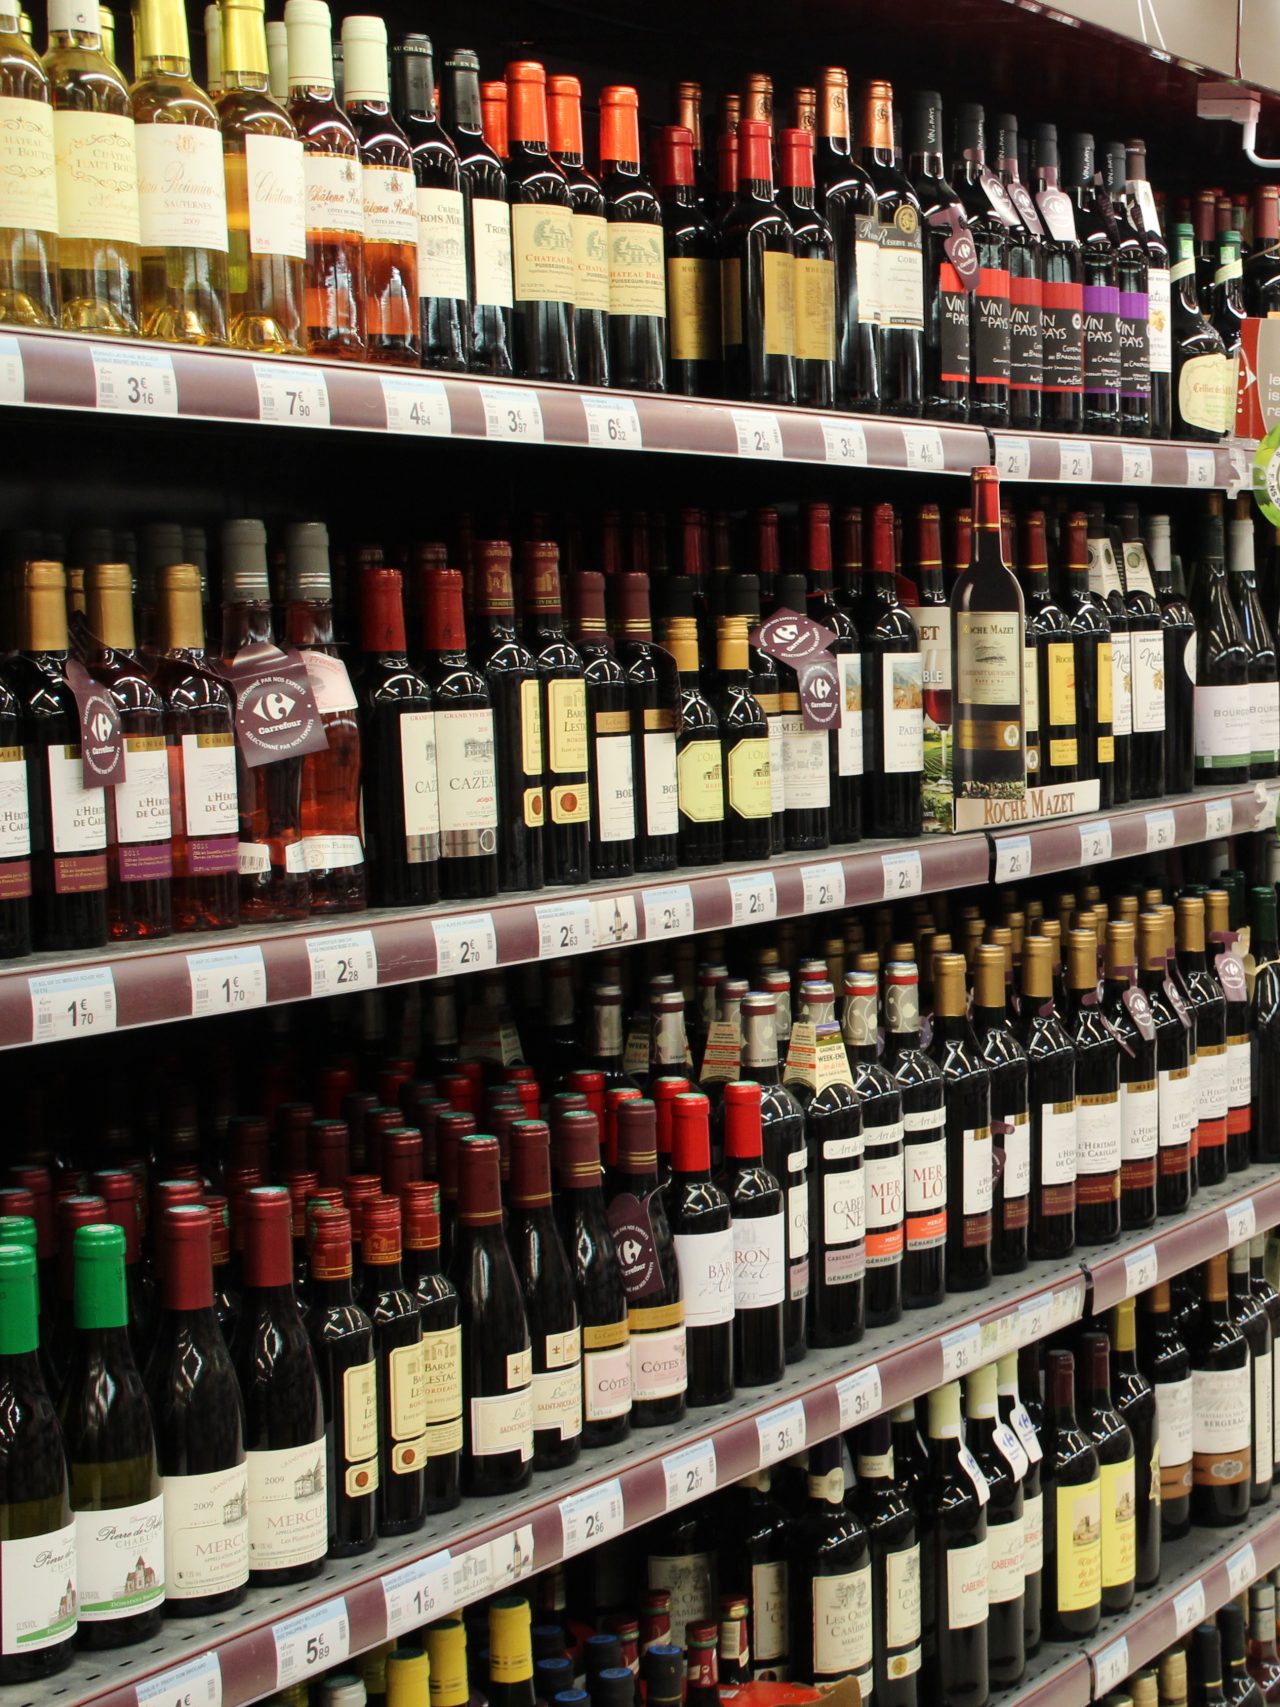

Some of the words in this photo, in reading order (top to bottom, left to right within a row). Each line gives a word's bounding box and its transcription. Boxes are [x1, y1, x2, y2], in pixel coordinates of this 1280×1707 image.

[945, 295, 966, 313] VIN
[980, 299, 1003, 317] VIN
[1013, 324, 1038, 337] PAYS
[1087, 331, 1113, 343] PAYS
[991, 625, 1014, 635] MAZET
[258, 719, 302, 735] Carrefour
[984, 798, 1028, 825] ROCHE
[1031, 788, 1075, 820] MAZET
[922, 1176, 945, 1200] LO
[880, 1191, 903, 1216] LO
[735, 1247, 770, 1265] RON
[424, 1361, 455, 1373] BARON
[641, 1357, 680, 1374] CÔTES
[1204, 1416, 1246, 1428] BERGERAC
[264, 1476, 285, 1485] 2009
[193, 1501, 214, 1511] 2009
[96, 1525, 133, 1542] Pierre
[134, 1525, 143, 1534] de
[33, 1549, 64, 1569] Pierre
